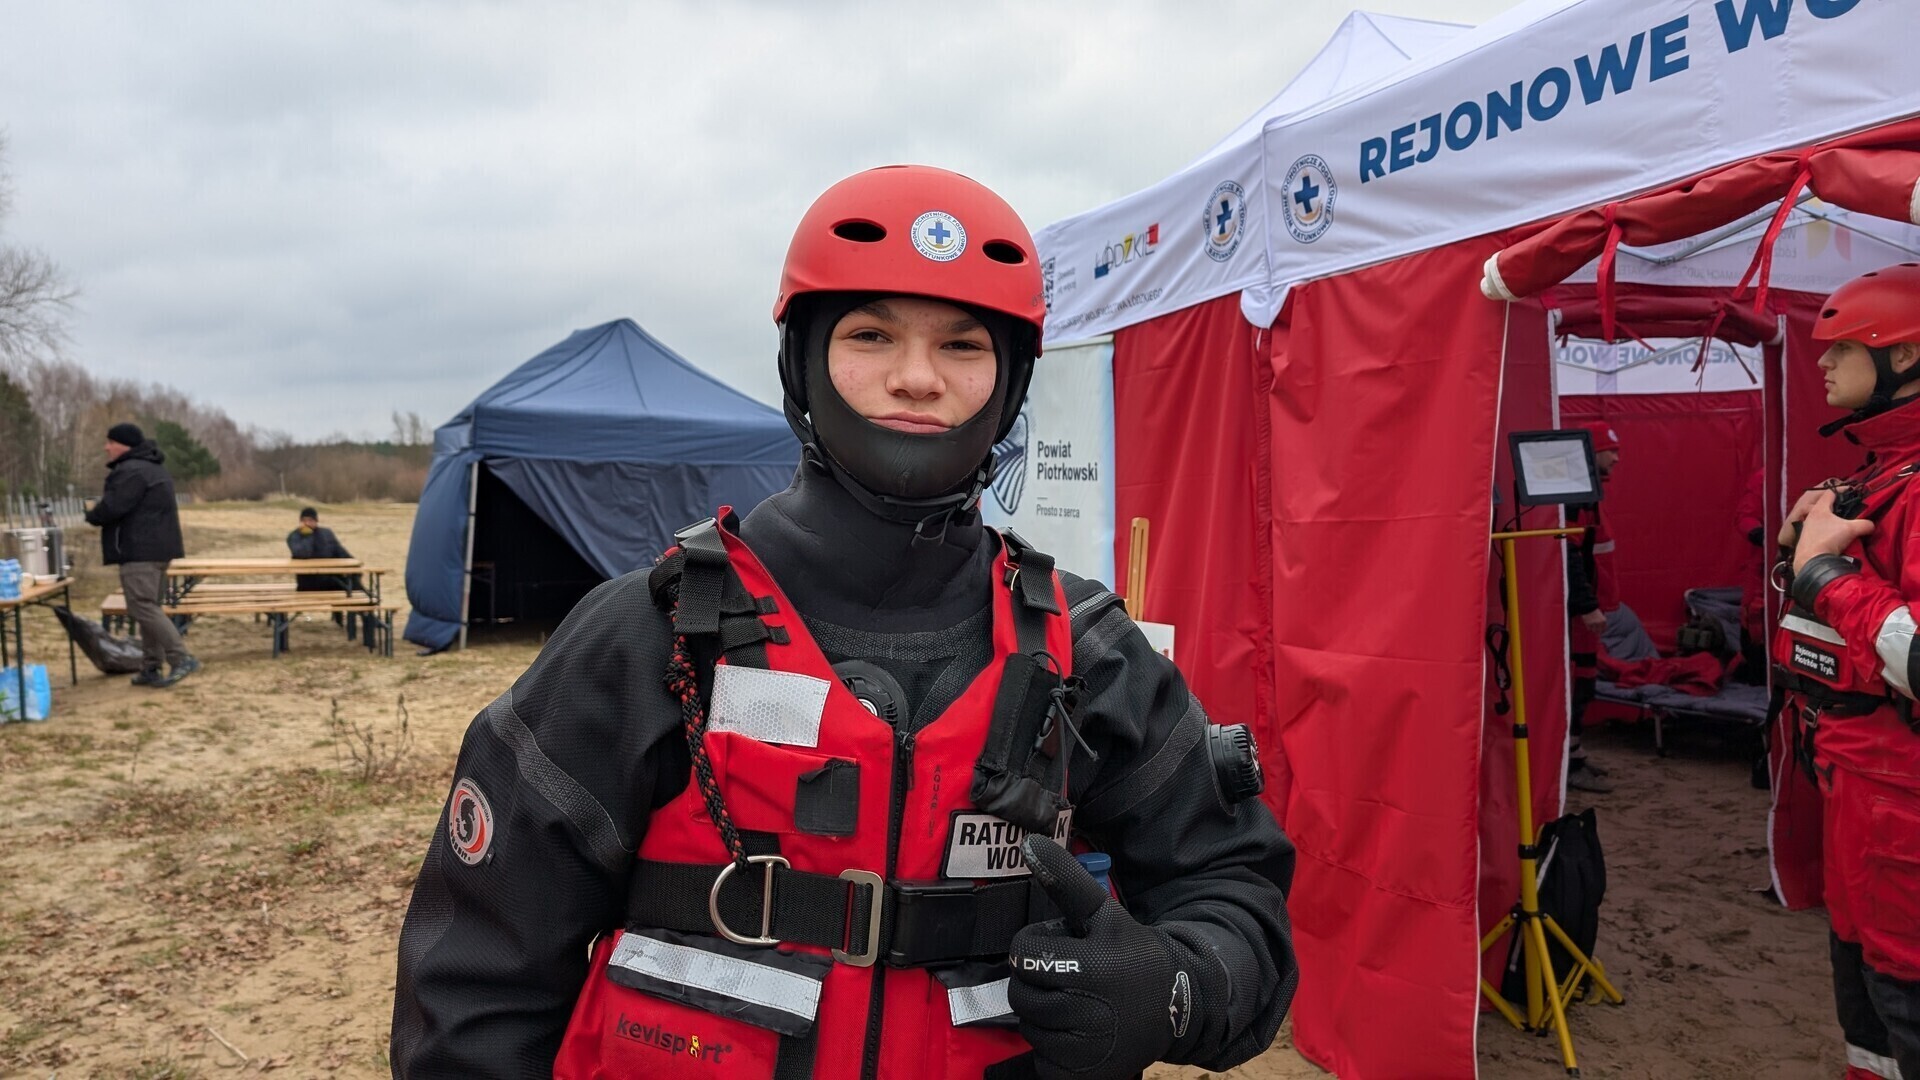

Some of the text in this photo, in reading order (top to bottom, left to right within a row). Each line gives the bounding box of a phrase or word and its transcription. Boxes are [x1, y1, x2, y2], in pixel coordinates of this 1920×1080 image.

[1359, 0, 1861, 183] REJONOWE W
[1037, 439, 1071, 458] Powiat
[1037, 462, 1098, 481] Piotrkowski
[1036, 504, 1080, 518] Prosto z serca
[959, 816, 1069, 845] RATOK
[1023, 958, 1080, 973] DIVER
[1178, 974, 1189, 1035] ARCTIC SURVIVOR
